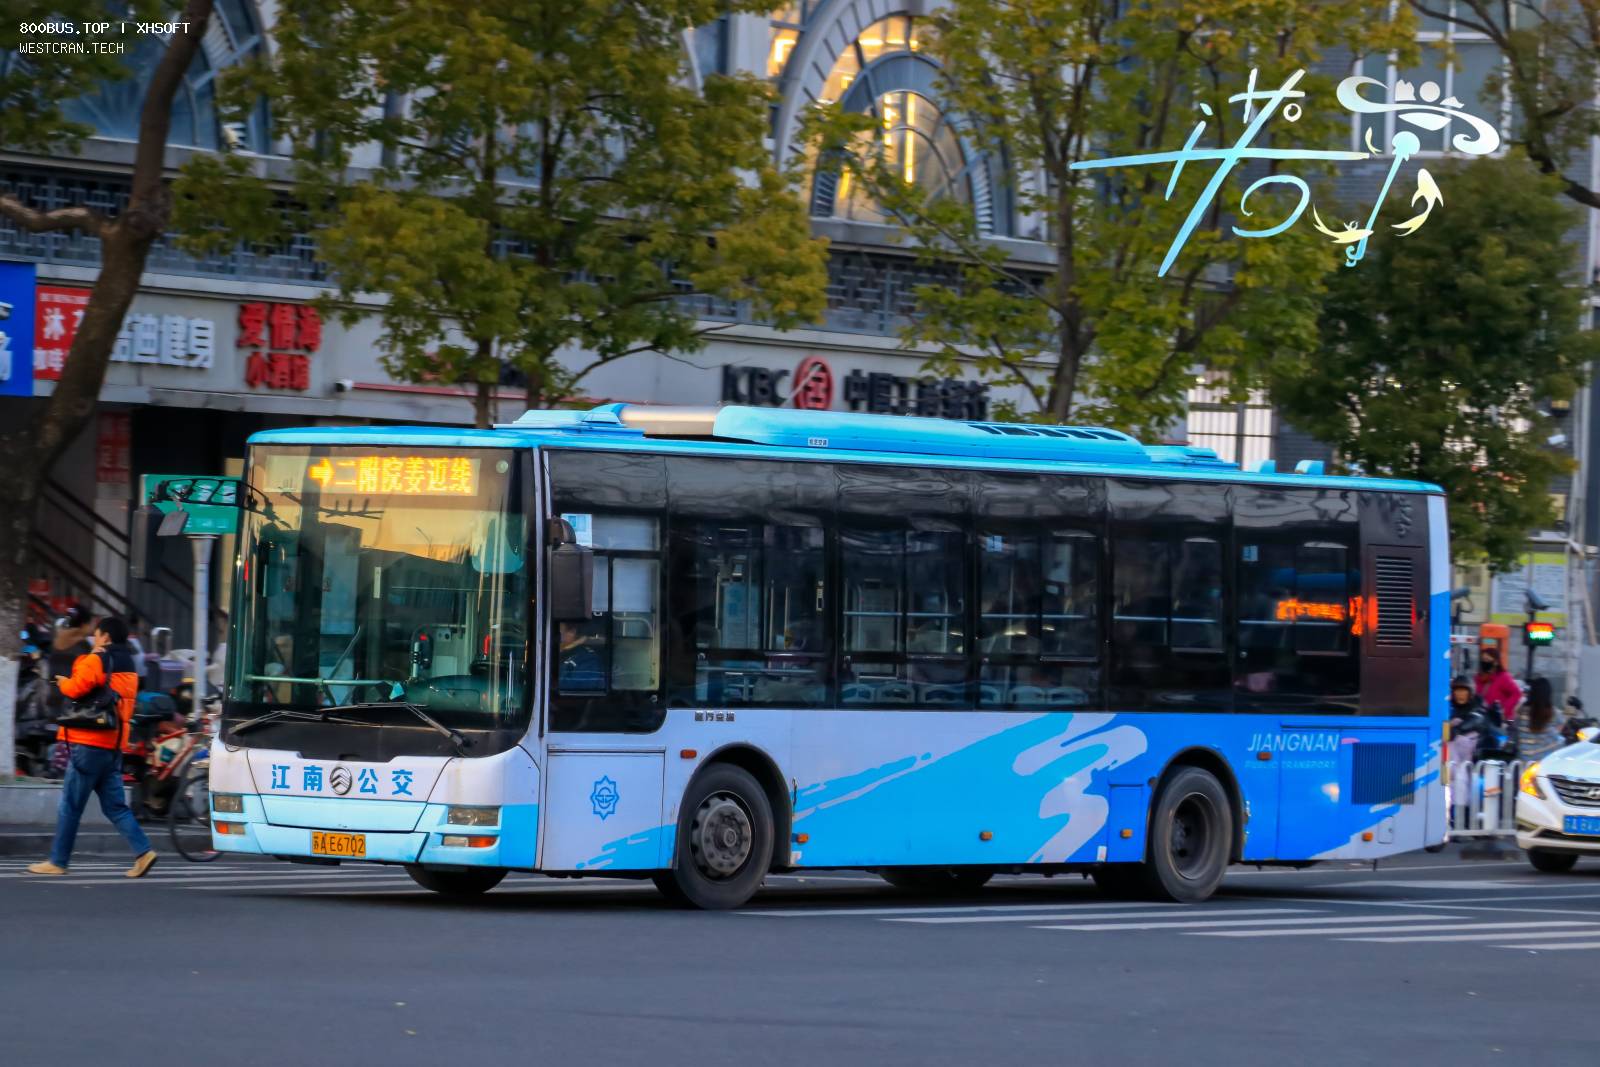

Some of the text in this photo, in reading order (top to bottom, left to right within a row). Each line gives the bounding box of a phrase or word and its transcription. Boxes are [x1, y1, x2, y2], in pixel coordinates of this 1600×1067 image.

[1247, 733, 1340, 752] JIANGNAN
[271, 764, 413, 796] 江南公交
